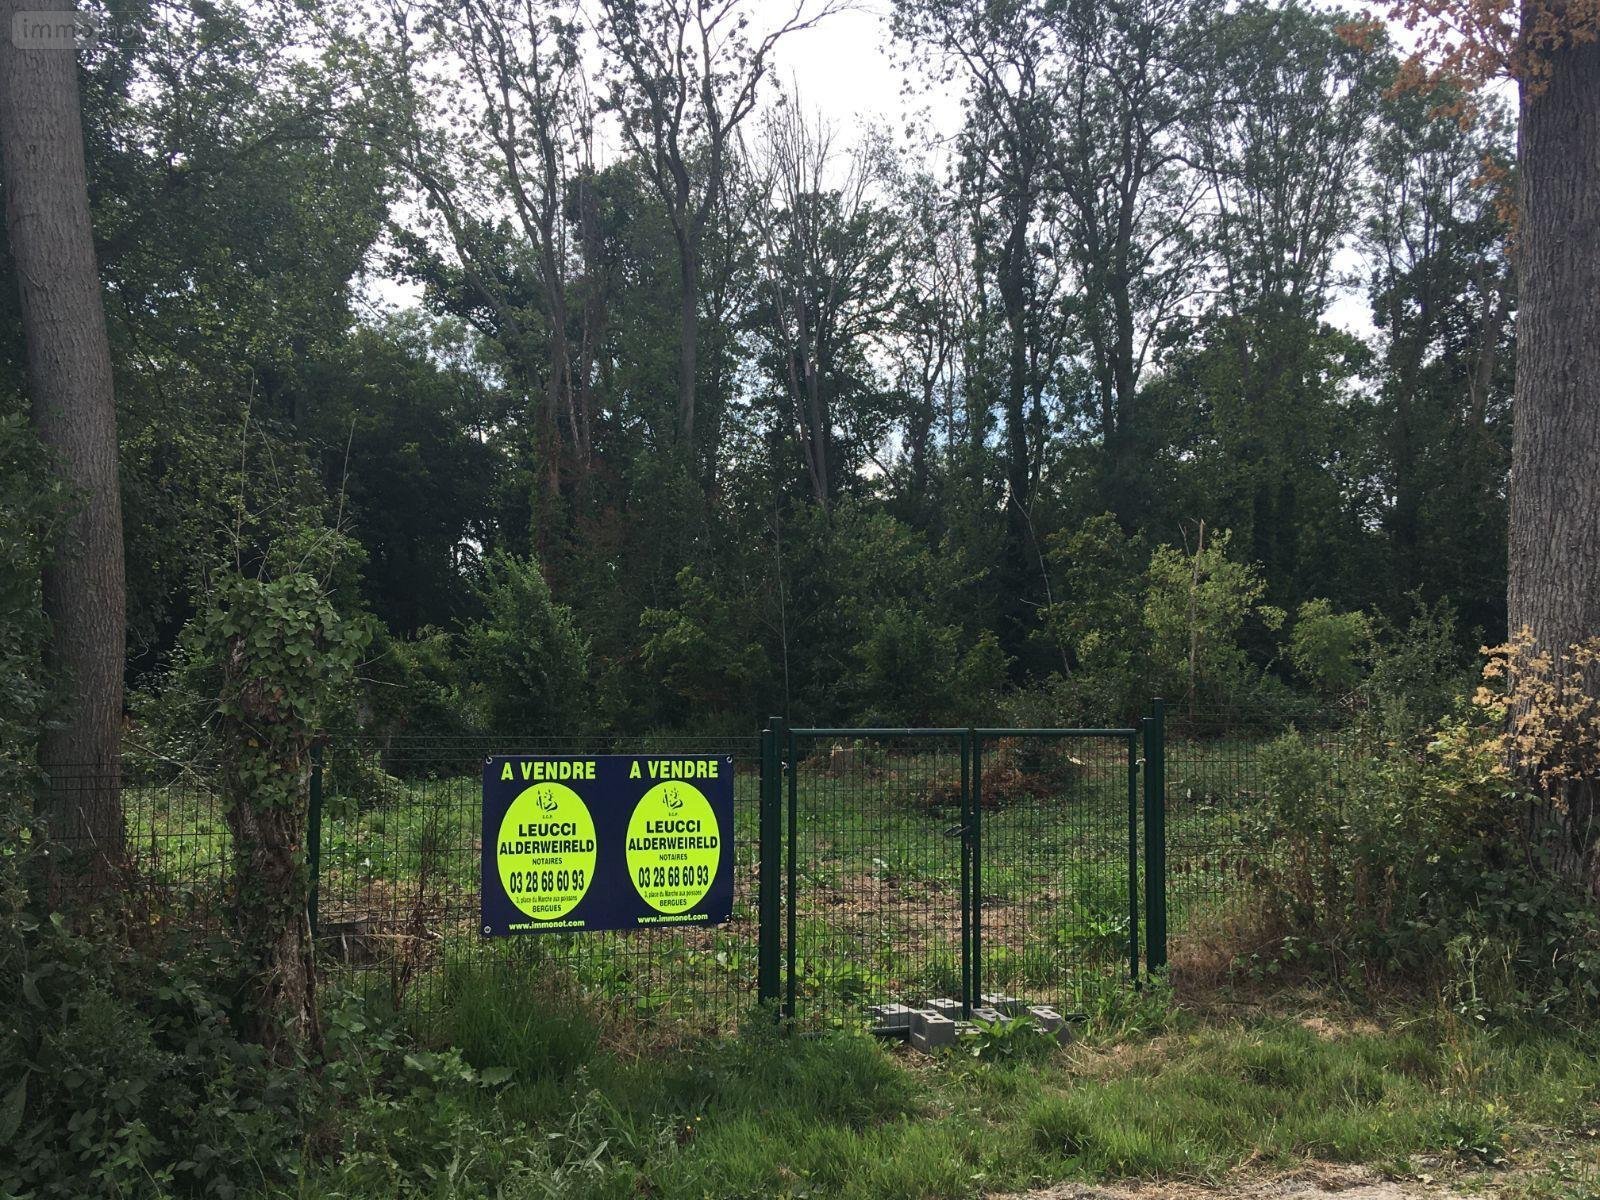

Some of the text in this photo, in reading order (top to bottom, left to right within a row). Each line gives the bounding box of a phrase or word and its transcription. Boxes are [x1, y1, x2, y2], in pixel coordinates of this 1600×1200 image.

[501, 761, 596, 780] A VENDRE
[630, 760, 719, 779] A VENDRE
[519, 823, 576, 837] LEUCCI
[646, 820, 701, 834] LEUCCI
[499, 839, 595, 856] ALDERWEIRELD
[628, 836, 718, 851] ALDERWEIRELD
[532, 857, 563, 866] NOTAIRES
[659, 853, 688, 861] NOTAIRES
[510, 869, 584, 893] 03 28 68 60 93
[638, 864, 709, 888] 03 28 68 60 93
[532, 904, 562, 912] BERGUES
[508, 920, 585, 930] www.immonot.com
[638, 914, 709, 924] www.immonot.com
